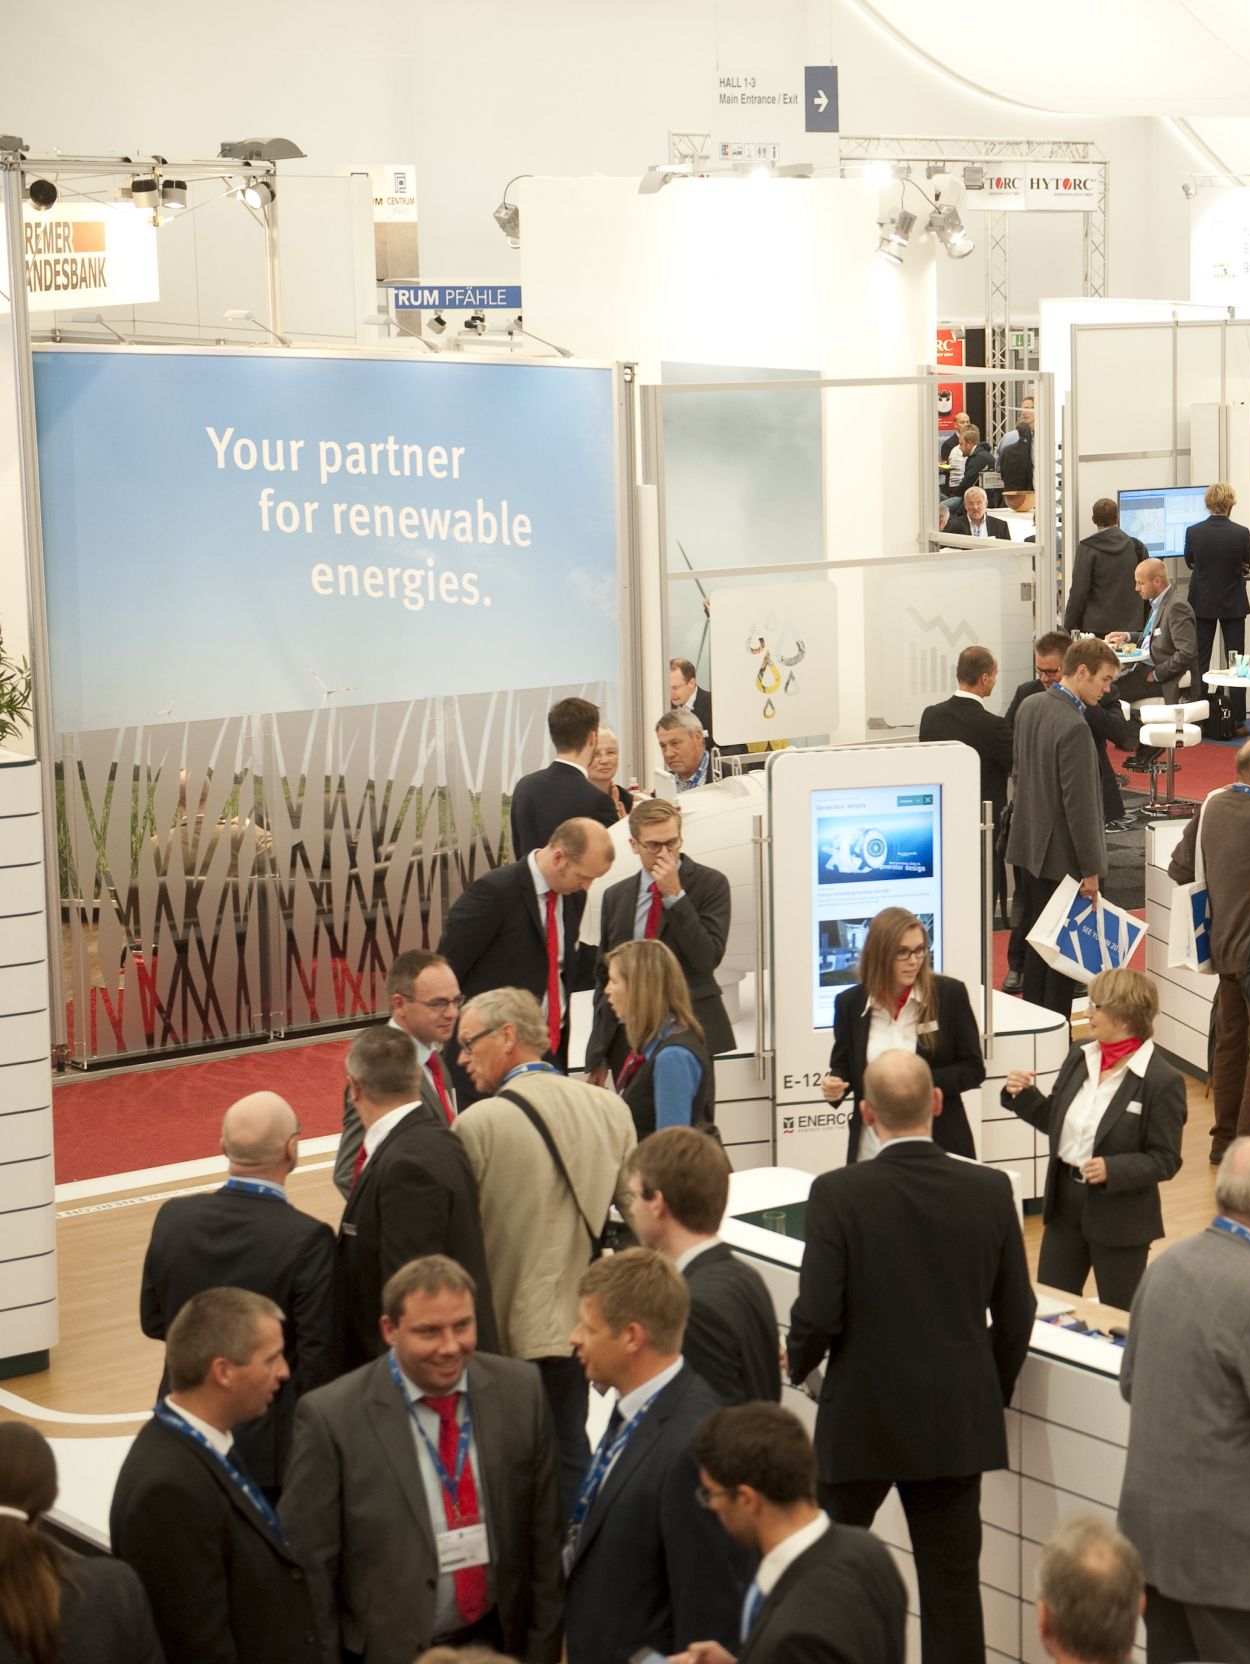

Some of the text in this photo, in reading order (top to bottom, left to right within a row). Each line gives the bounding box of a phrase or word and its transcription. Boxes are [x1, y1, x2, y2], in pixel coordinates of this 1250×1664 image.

[719, 77, 756, 88] HALL 1-3
[719, 93, 738, 104] Main
[740, 93, 776, 104] Entrance
[783, 93, 798, 104] Exit
[1030, 177, 1093, 190] HYTORC
[445, 287, 507, 305] PFÄHLE
[205, 426, 466, 485] Your partner
[258, 487, 533, 548] for renewable
[310, 557, 492, 612] energies.
[784, 1071, 831, 1090] E-12
